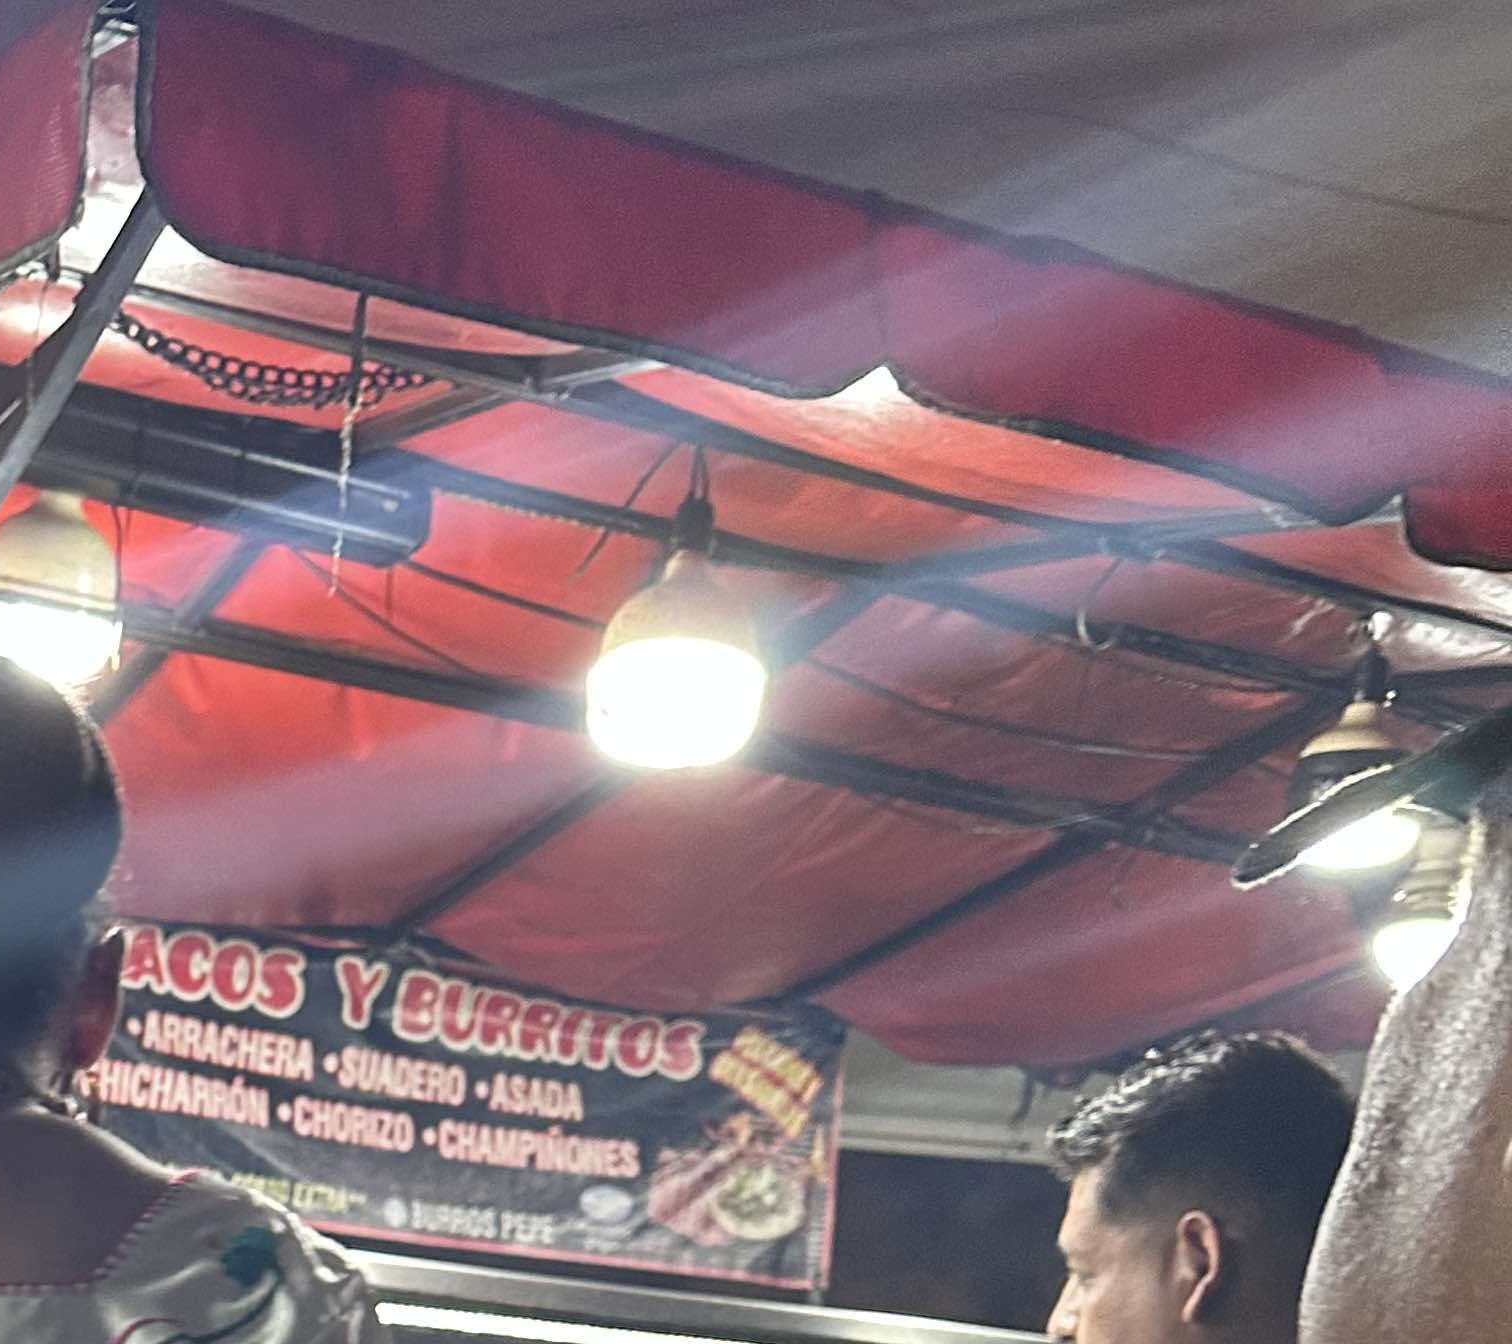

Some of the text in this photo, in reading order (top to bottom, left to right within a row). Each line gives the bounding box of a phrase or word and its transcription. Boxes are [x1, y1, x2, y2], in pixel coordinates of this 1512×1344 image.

[120, 924, 306, 1018] ACOS
[335, 954, 388, 1031] Y
[392, 969, 706, 1081] BURRITOS
[142, 1009, 584, 1122] ARRACHERA SUADERO ASADA
[292, 1094, 415, 1153] CHORIZO
[437, 1118, 641, 1179] CHAMPIÑONES
